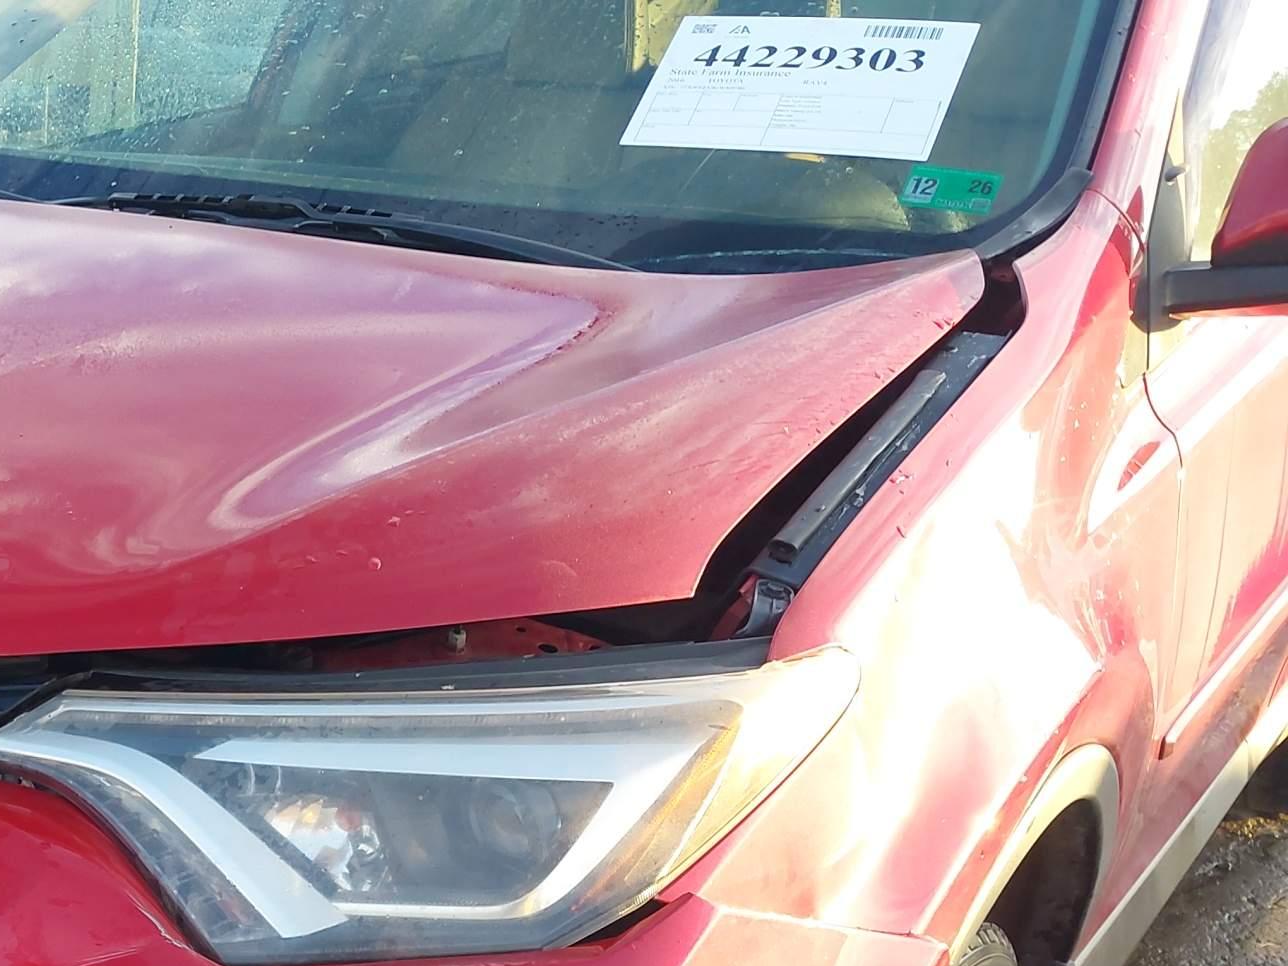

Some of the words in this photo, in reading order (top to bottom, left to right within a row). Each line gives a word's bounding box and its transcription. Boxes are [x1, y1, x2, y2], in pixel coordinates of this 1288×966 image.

[693, 44, 926, 72] 44229303
[669, 68, 698, 76] State
[701, 68, 731, 76] Farm
[734, 68, 792, 77] Insurance
[910, 177, 938, 195] 12
[968, 179, 994, 195] 26
